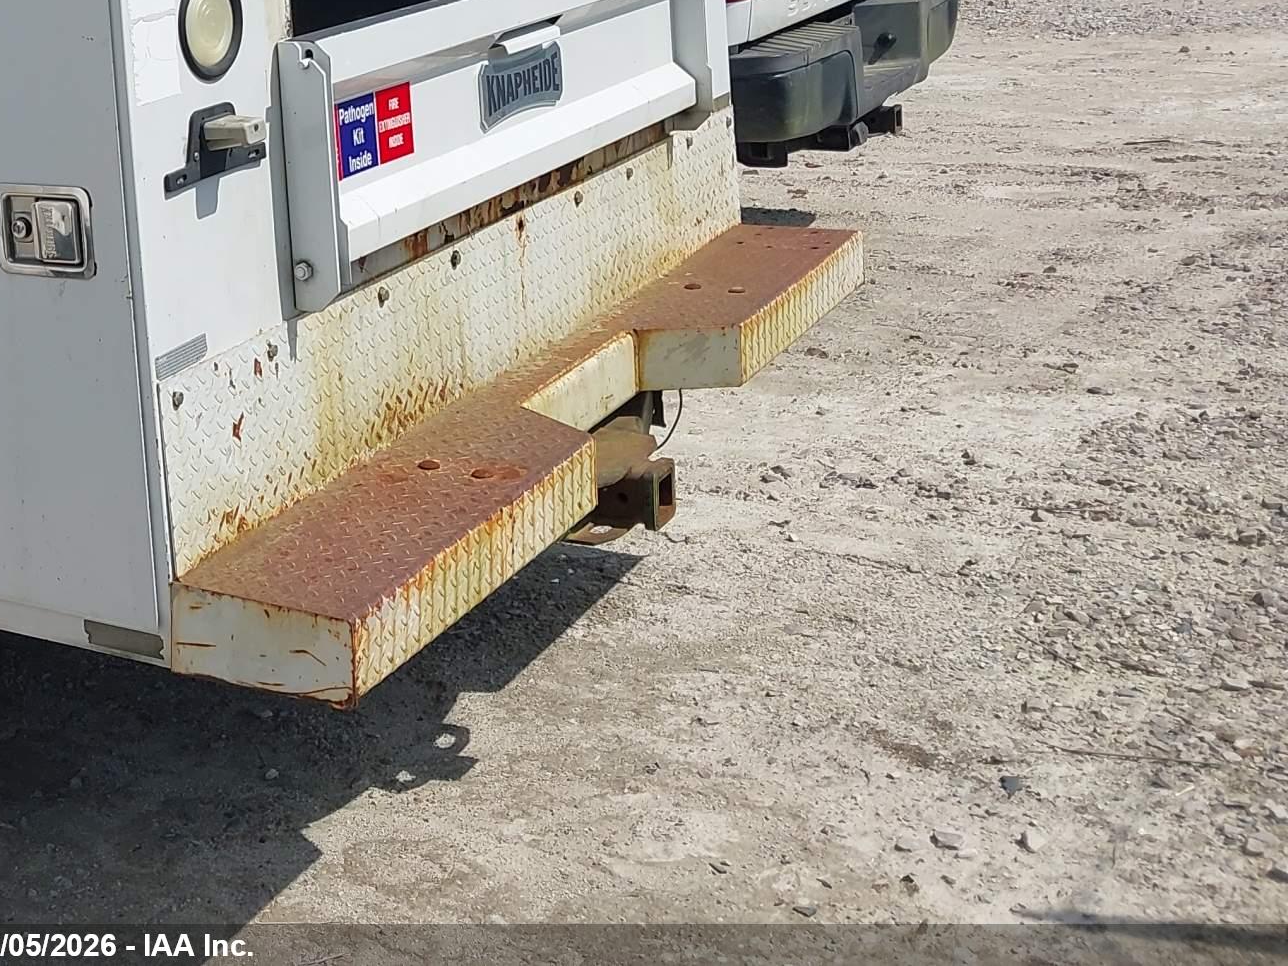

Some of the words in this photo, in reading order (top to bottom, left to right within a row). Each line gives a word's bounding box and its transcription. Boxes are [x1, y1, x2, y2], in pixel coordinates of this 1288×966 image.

[486, 51, 560, 117] KNAPHEIDE
[339, 102, 375, 126] Pathogen
[353, 127, 365, 146] Kit
[349, 150, 373, 173] Inside
